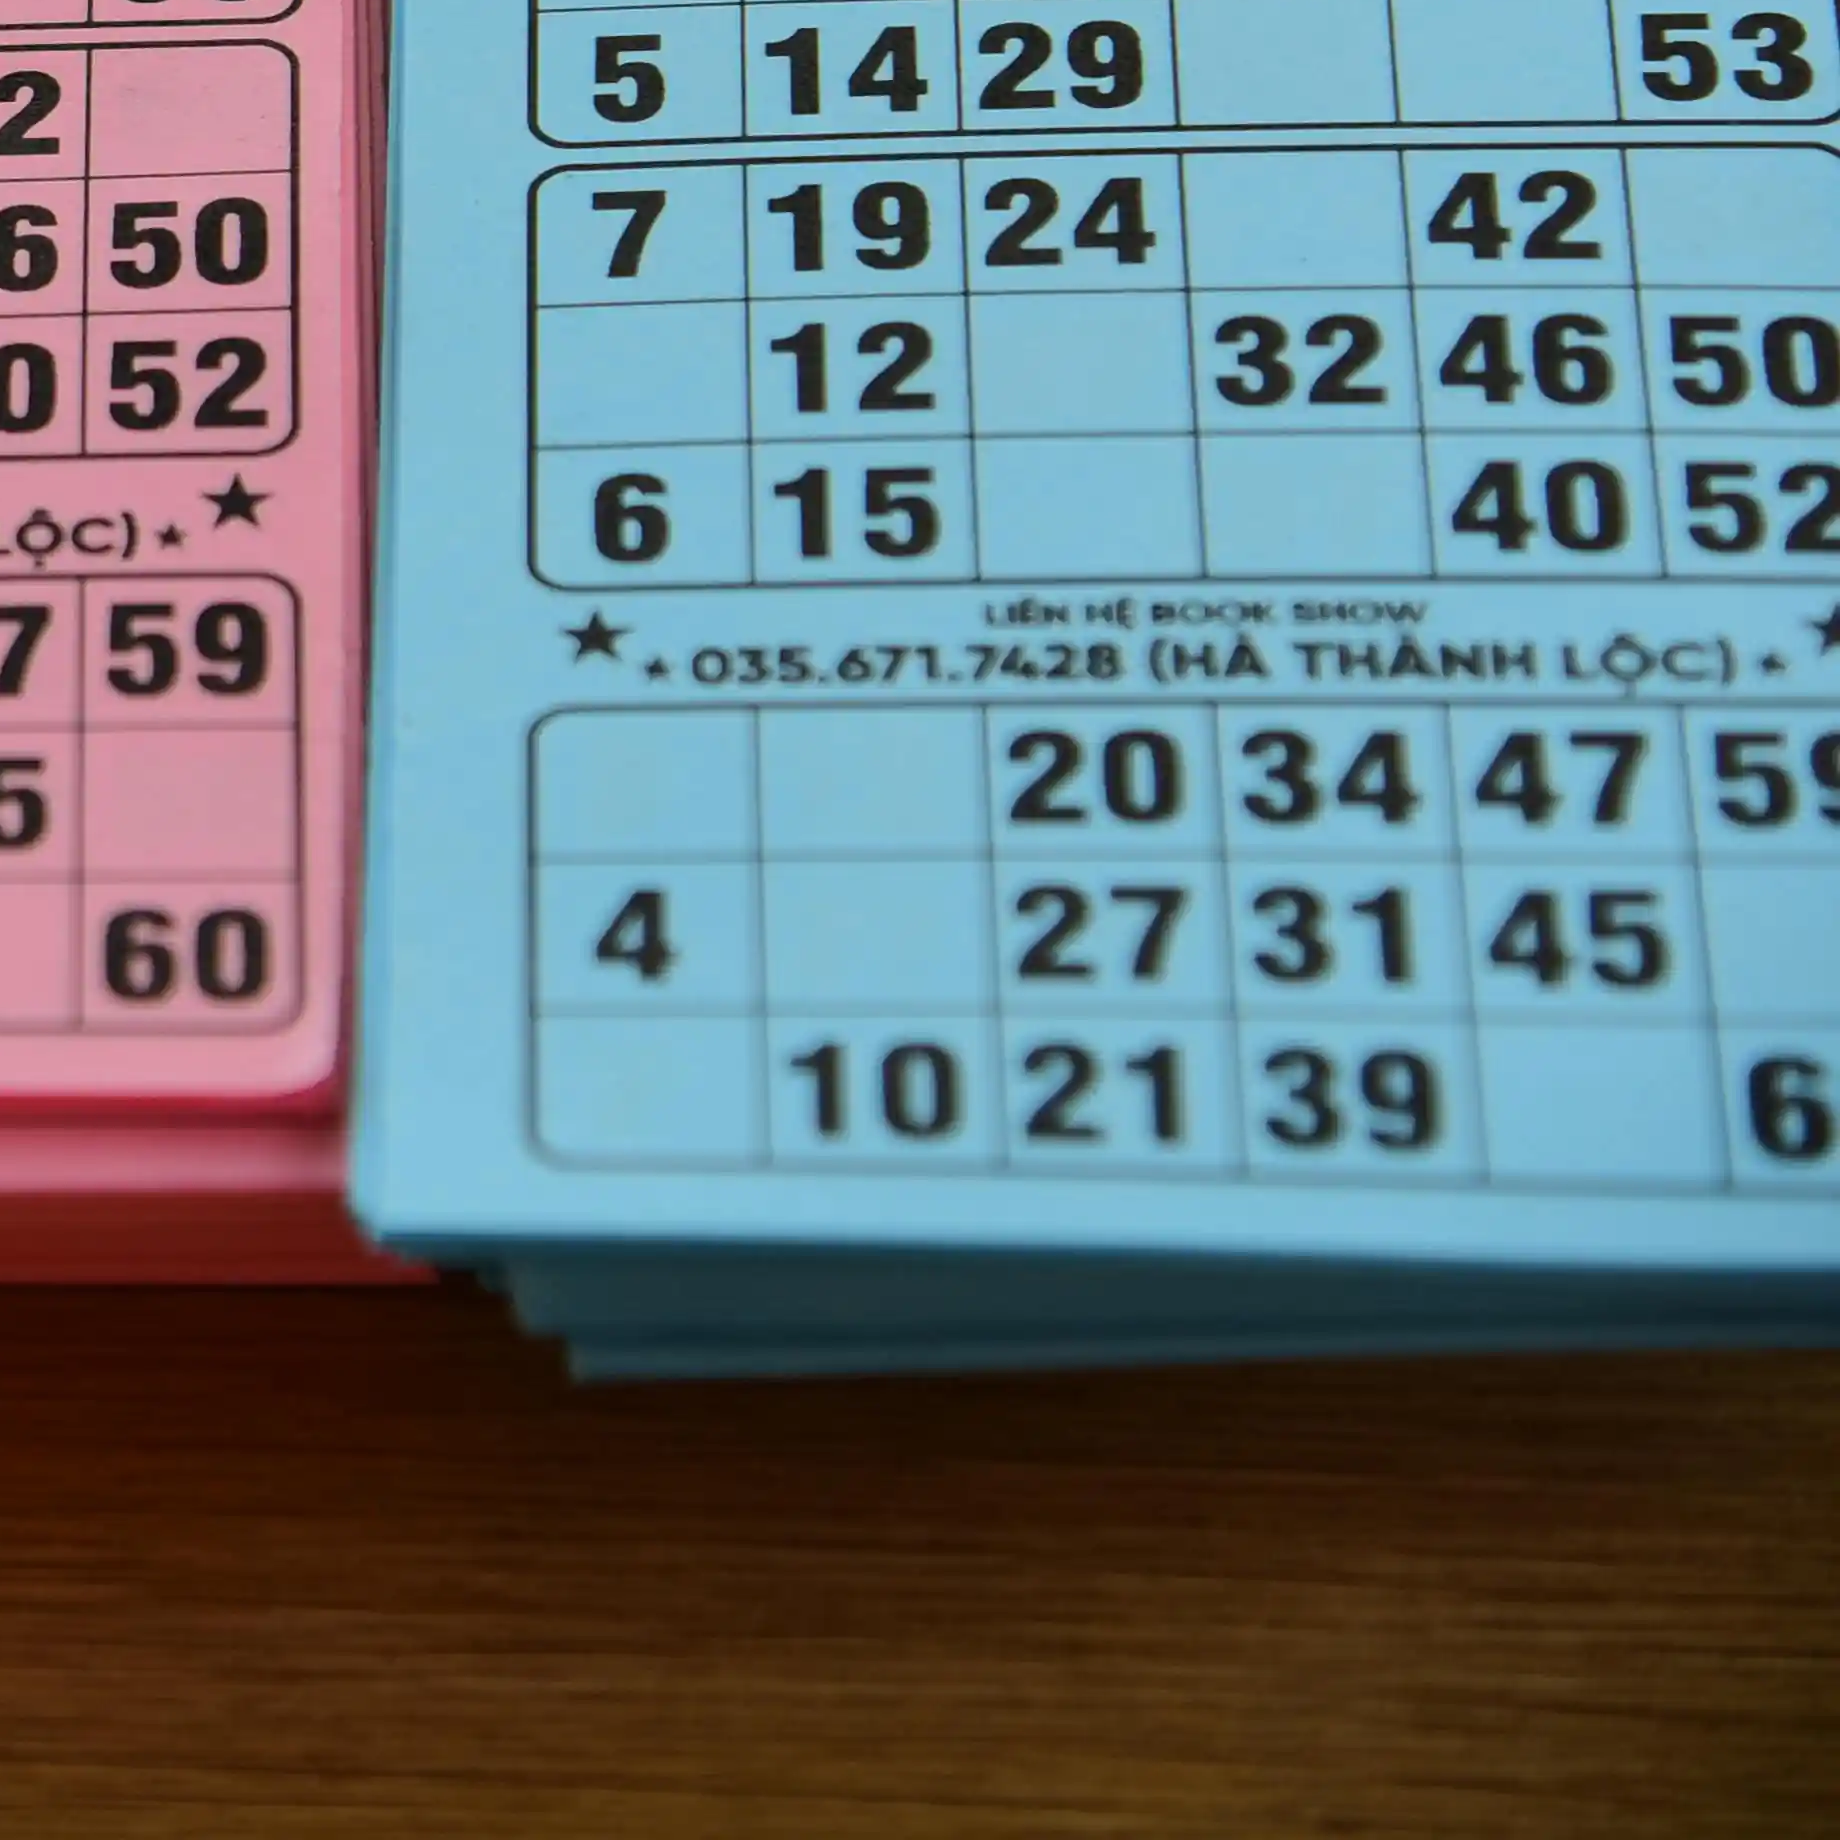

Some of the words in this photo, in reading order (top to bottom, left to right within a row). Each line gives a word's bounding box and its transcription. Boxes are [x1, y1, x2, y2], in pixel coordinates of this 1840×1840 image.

[592, 33, 667, 124] 5
[763, 24, 929, 117] 14
[977, 19, 1144, 111] 29
[1639, 11, 1814, 103] 53
[107, 335, 270, 433] 52
[769, 320, 936, 414] 12
[1213, 312, 1387, 408] 32
[1437, 311, 1614, 407] 46
[1668, 314, 1840, 410] 50
[1007, 728, 1183, 825] 20
[1240, 728, 1420, 826] 34
[1473, 730, 1646, 826] 47
[594, 888, 675, 982] 4
[1014, 883, 1186, 981] 27
[1251, 884, 1412, 985] 31
[1487, 888, 1669, 991] 45
